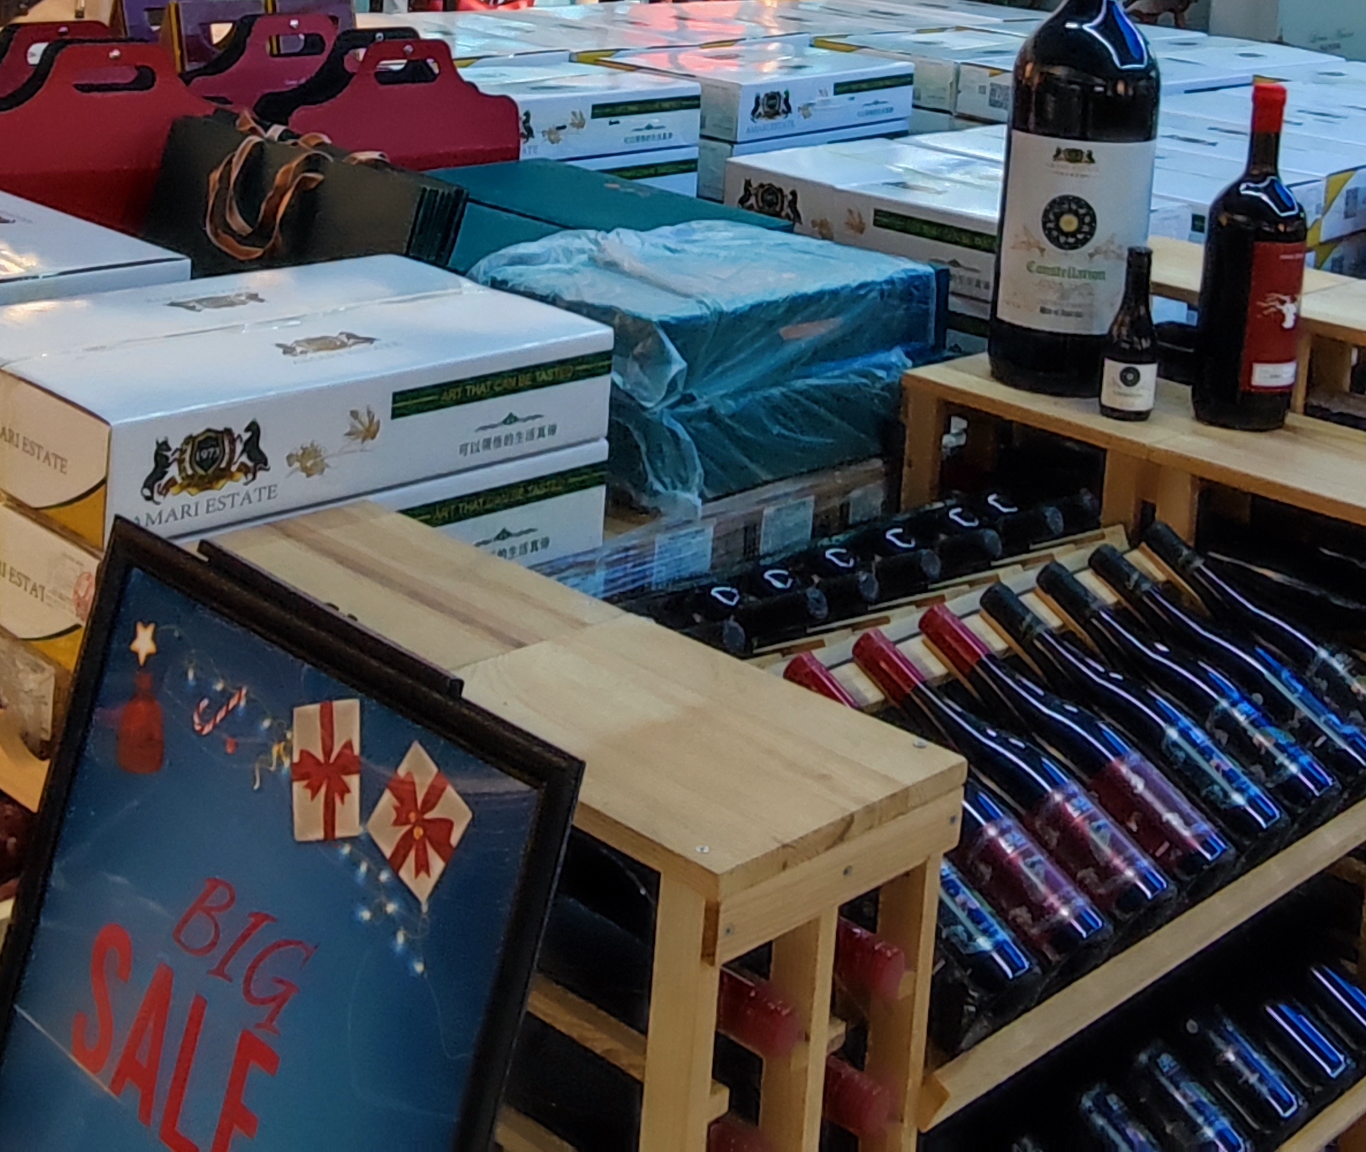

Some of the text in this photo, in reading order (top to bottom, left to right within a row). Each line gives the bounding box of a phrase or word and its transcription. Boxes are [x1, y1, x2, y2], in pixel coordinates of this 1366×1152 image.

[440, 364, 575, 402] ART THAT CAN BE TASTED
[21, 437, 69, 476] ESTATE
[205, 483, 279, 516] ESTATE
[8, 565, 46, 603] ESTAT
[171, 876, 318, 1036] BIG
[70, 923, 282, 1152] SALE
